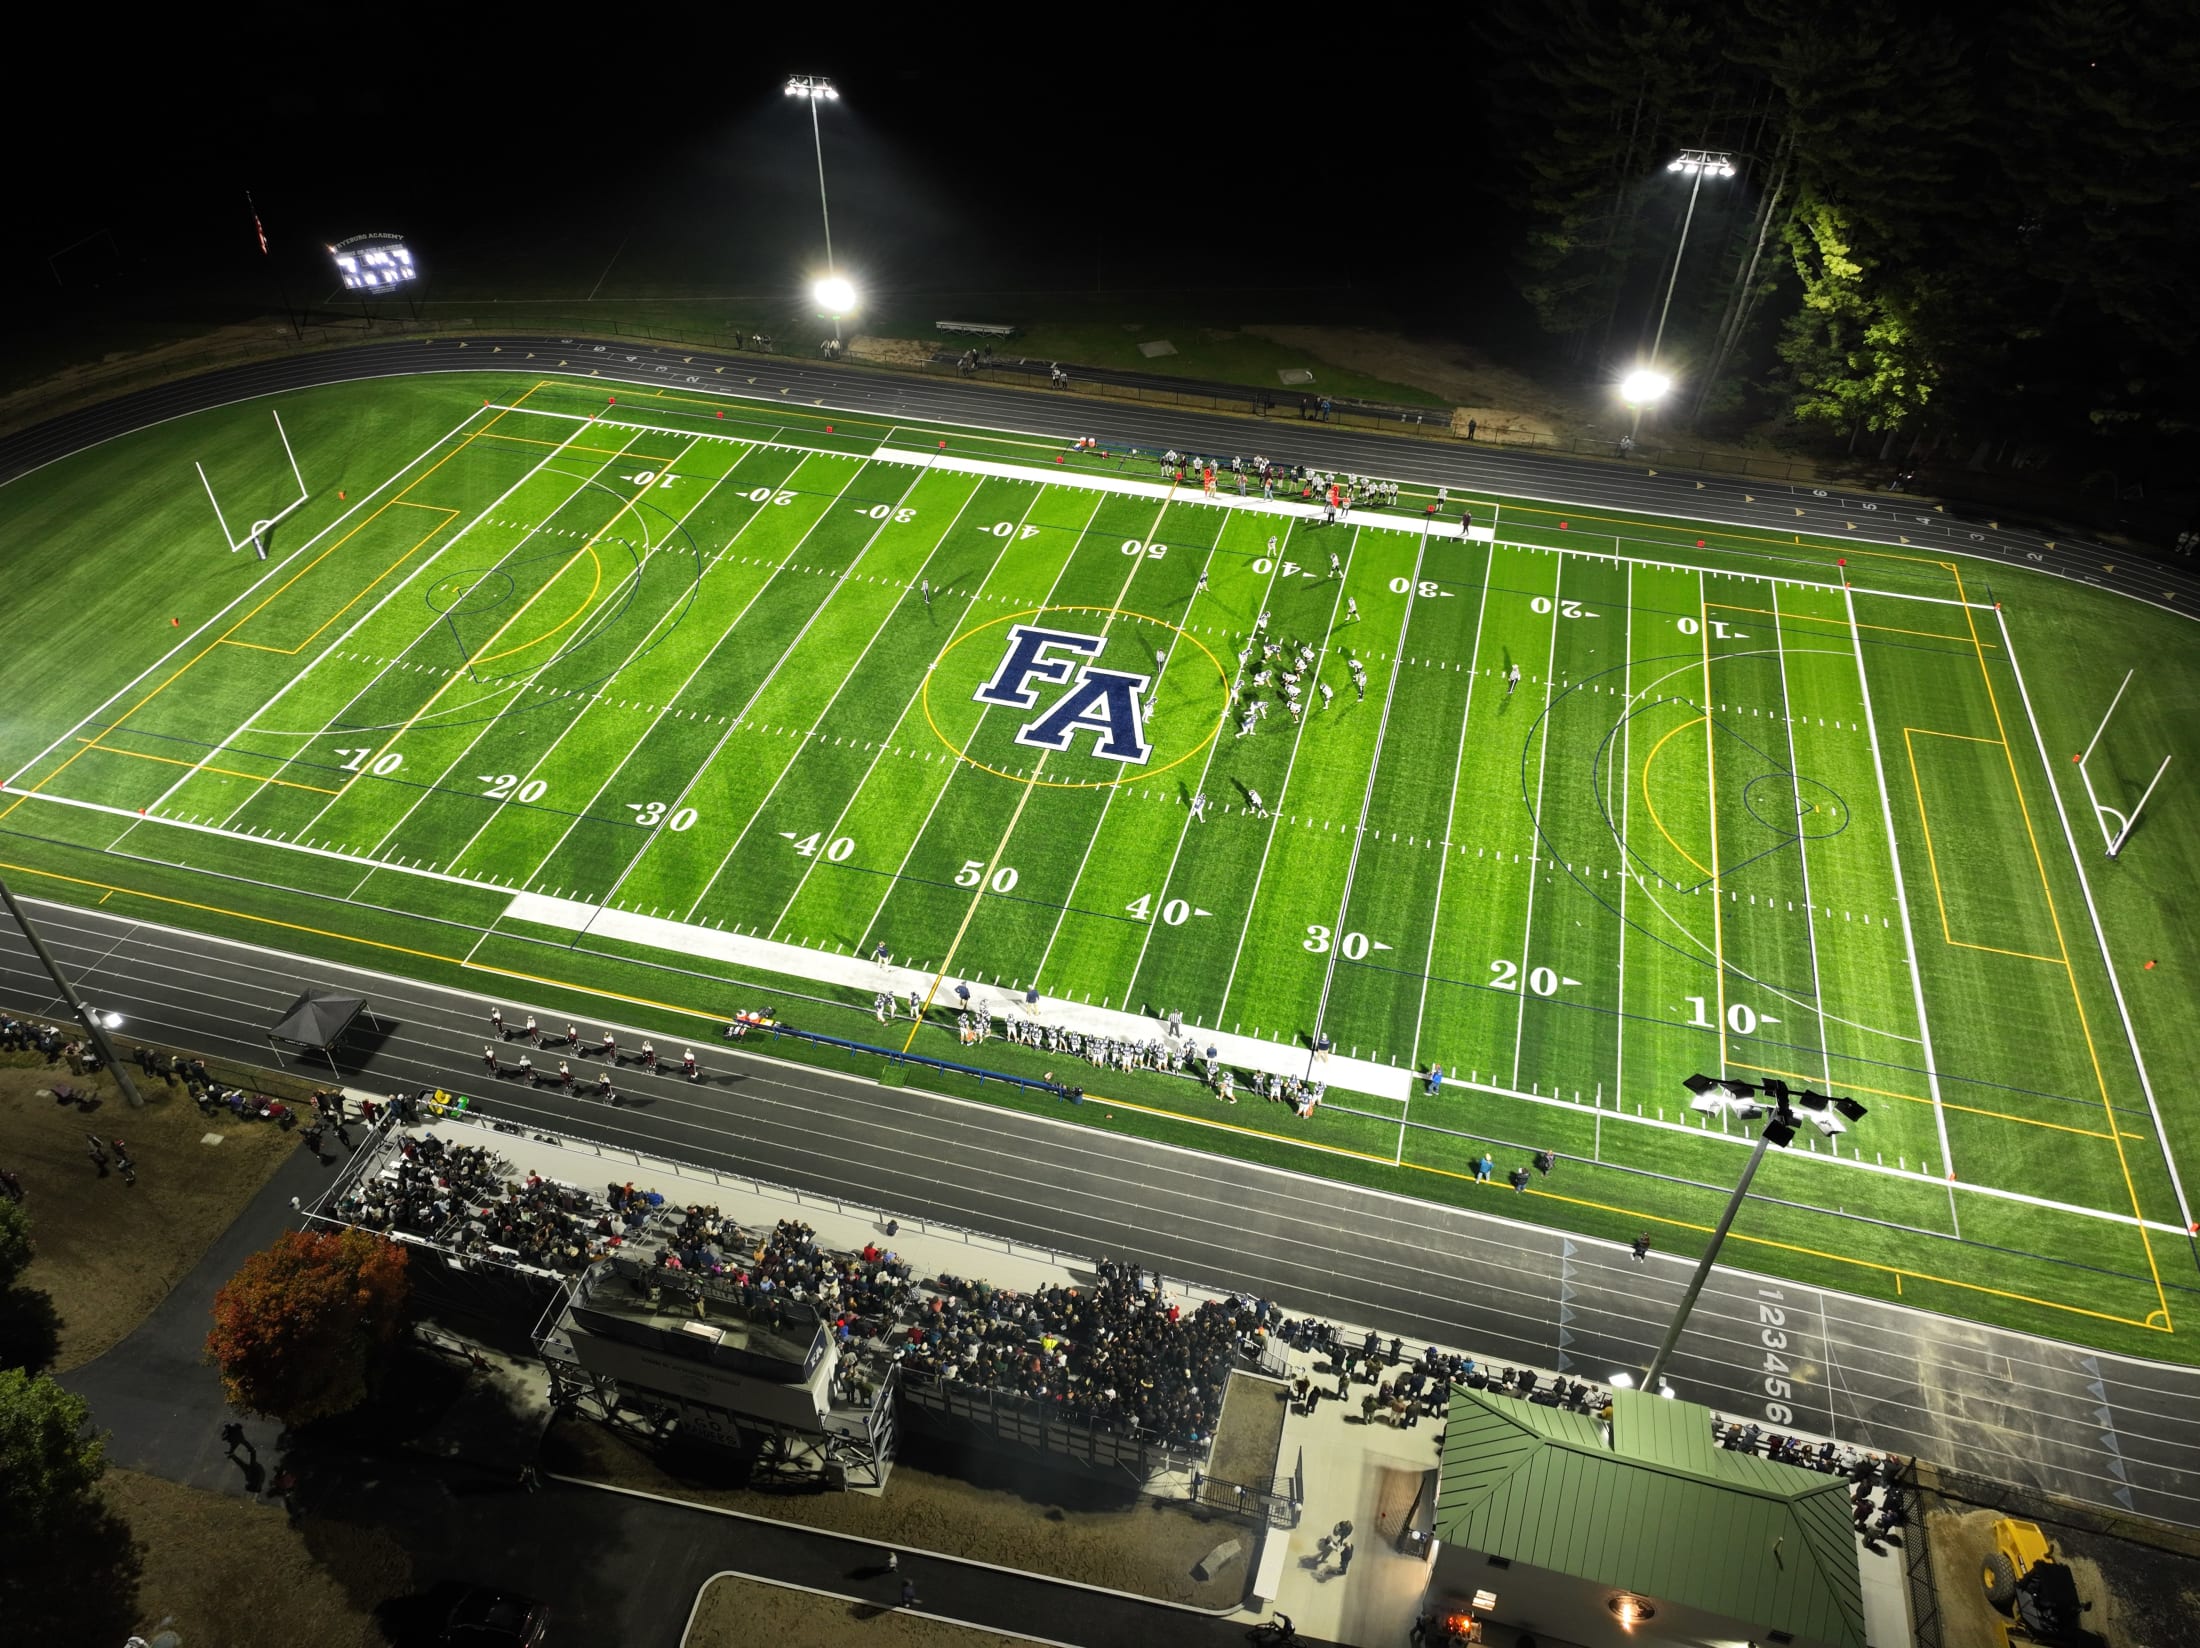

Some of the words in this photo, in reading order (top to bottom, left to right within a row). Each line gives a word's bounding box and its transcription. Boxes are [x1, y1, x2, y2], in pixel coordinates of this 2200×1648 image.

[632, 470, 682, 489] 10
[749, 487, 798, 506] 20
[869, 503, 917, 523] 30
[993, 520, 1041, 540] 40
[1121, 540, 1168, 560] 50
[1252, 558, 1302, 579] 40
[1389, 577, 1439, 599] 30
[1530, 597, 1583, 619] 20
[1677, 617, 1732, 639] 10
[972, 623, 1154, 766] FA
[339, 748, 403, 776] 10
[481, 773, 548, 804] 20
[634, 801, 699, 832] 30
[791, 834, 856, 862] 40
[954, 860, 1019, 893] 50
[1125, 893, 1190, 926] 40
[1303, 924, 1370, 961] 30
[1488, 959, 1558, 997] 20
[1684, 996, 1757, 1035] 10
